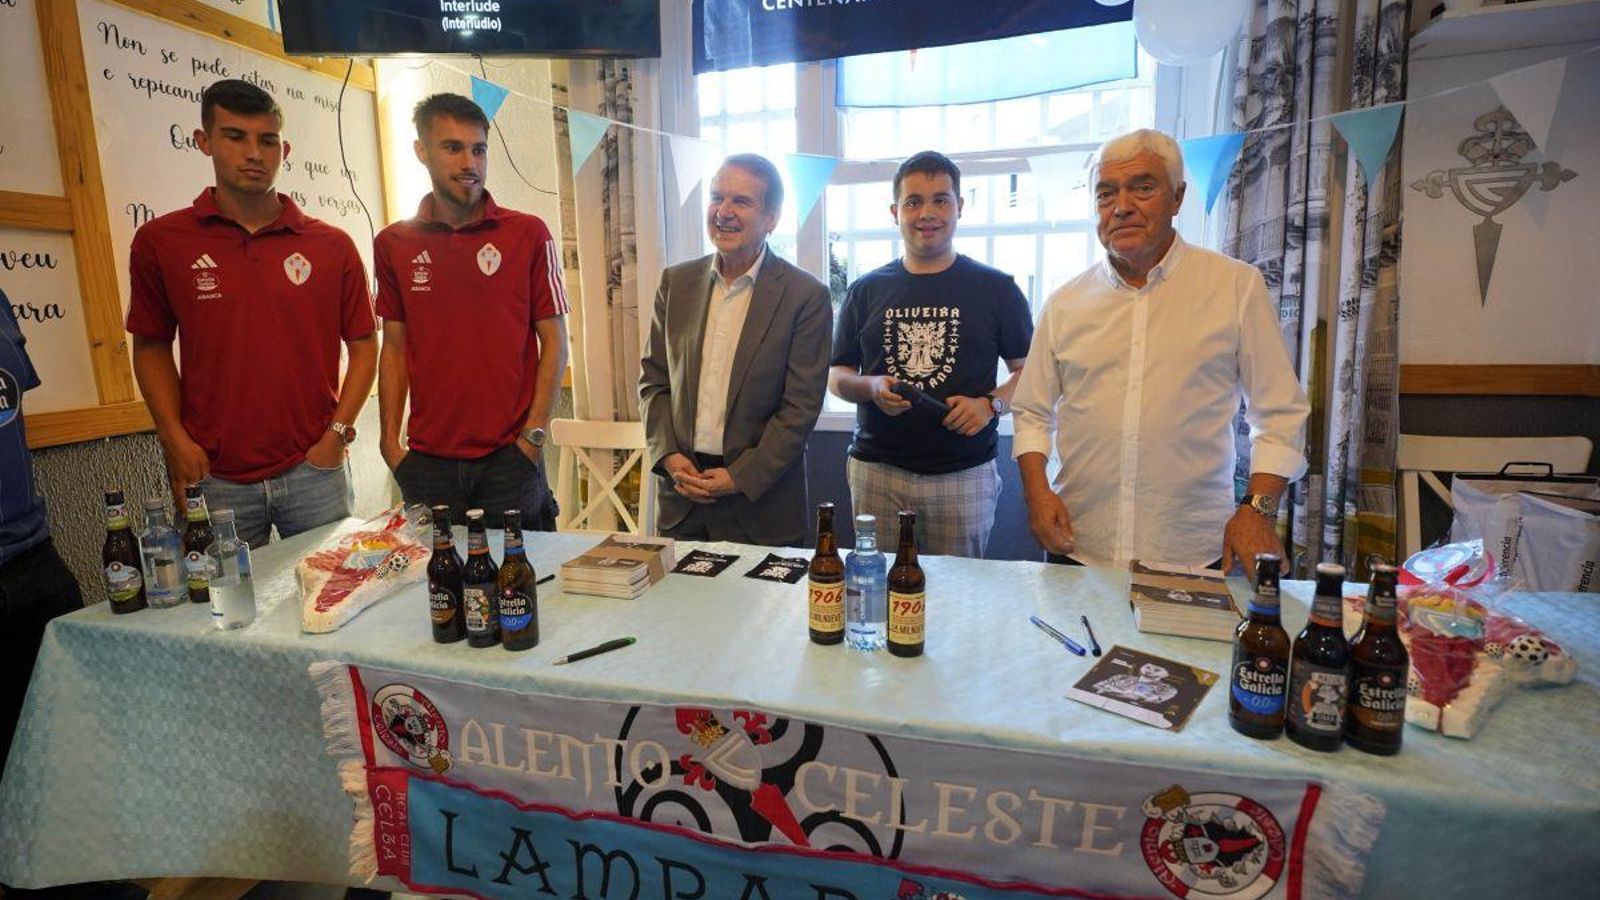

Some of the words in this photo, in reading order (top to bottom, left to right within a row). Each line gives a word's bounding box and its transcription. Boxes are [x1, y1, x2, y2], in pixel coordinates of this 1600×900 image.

[440, 0, 501, 12] Interlude
[97, 21, 148, 56] Non
[160, 48, 180, 64] se
[191, 57, 232, 78] pode
[286, 87, 305, 101] na
[103, 68, 114, 81] e
[127, 72, 206, 104] repicand
[304, 160, 331, 181] que
[318, 194, 361, 217] verzas
[884, 306, 961, 319] OLIVEIRA
[809, 588, 843, 603] 1906
[1238, 666, 1285, 684] Estrella
[1240, 678, 1282, 696] Galicia
[457, 718, 671, 798] ALENTO
[438, 808, 862, 900] LAMP
